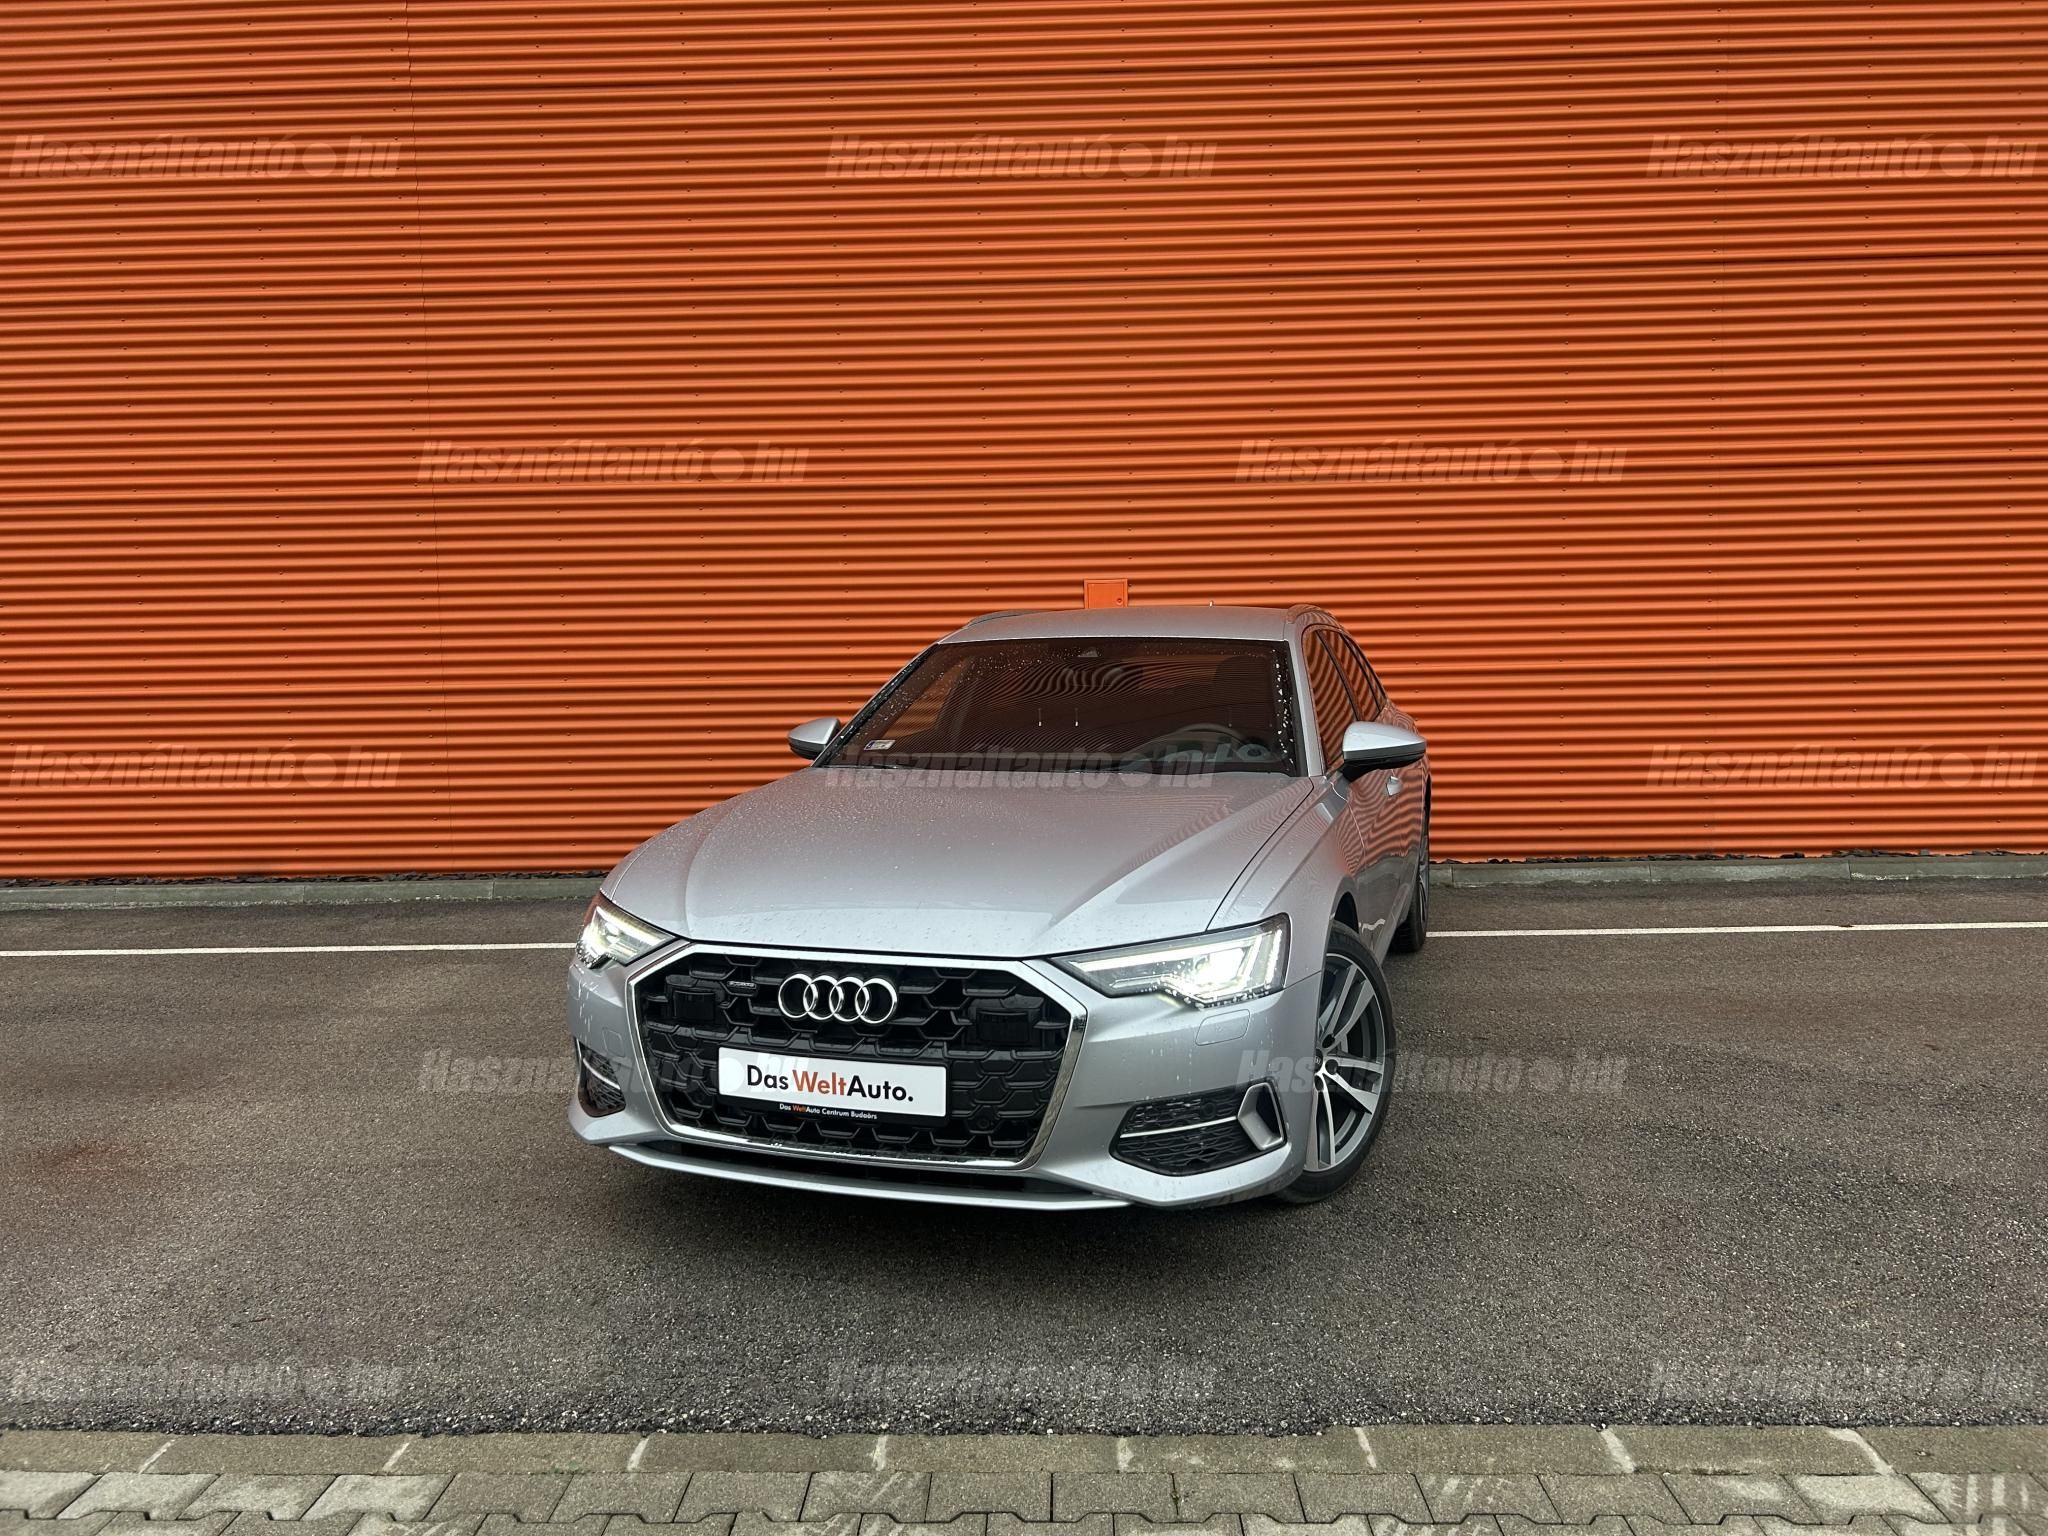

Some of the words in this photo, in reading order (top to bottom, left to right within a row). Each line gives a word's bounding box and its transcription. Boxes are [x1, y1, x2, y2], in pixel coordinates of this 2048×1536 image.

[747, 1064, 789, 1090] Das
[779, 1103, 791, 1111] Das
[821, 1108, 849, 1117] Centrum
